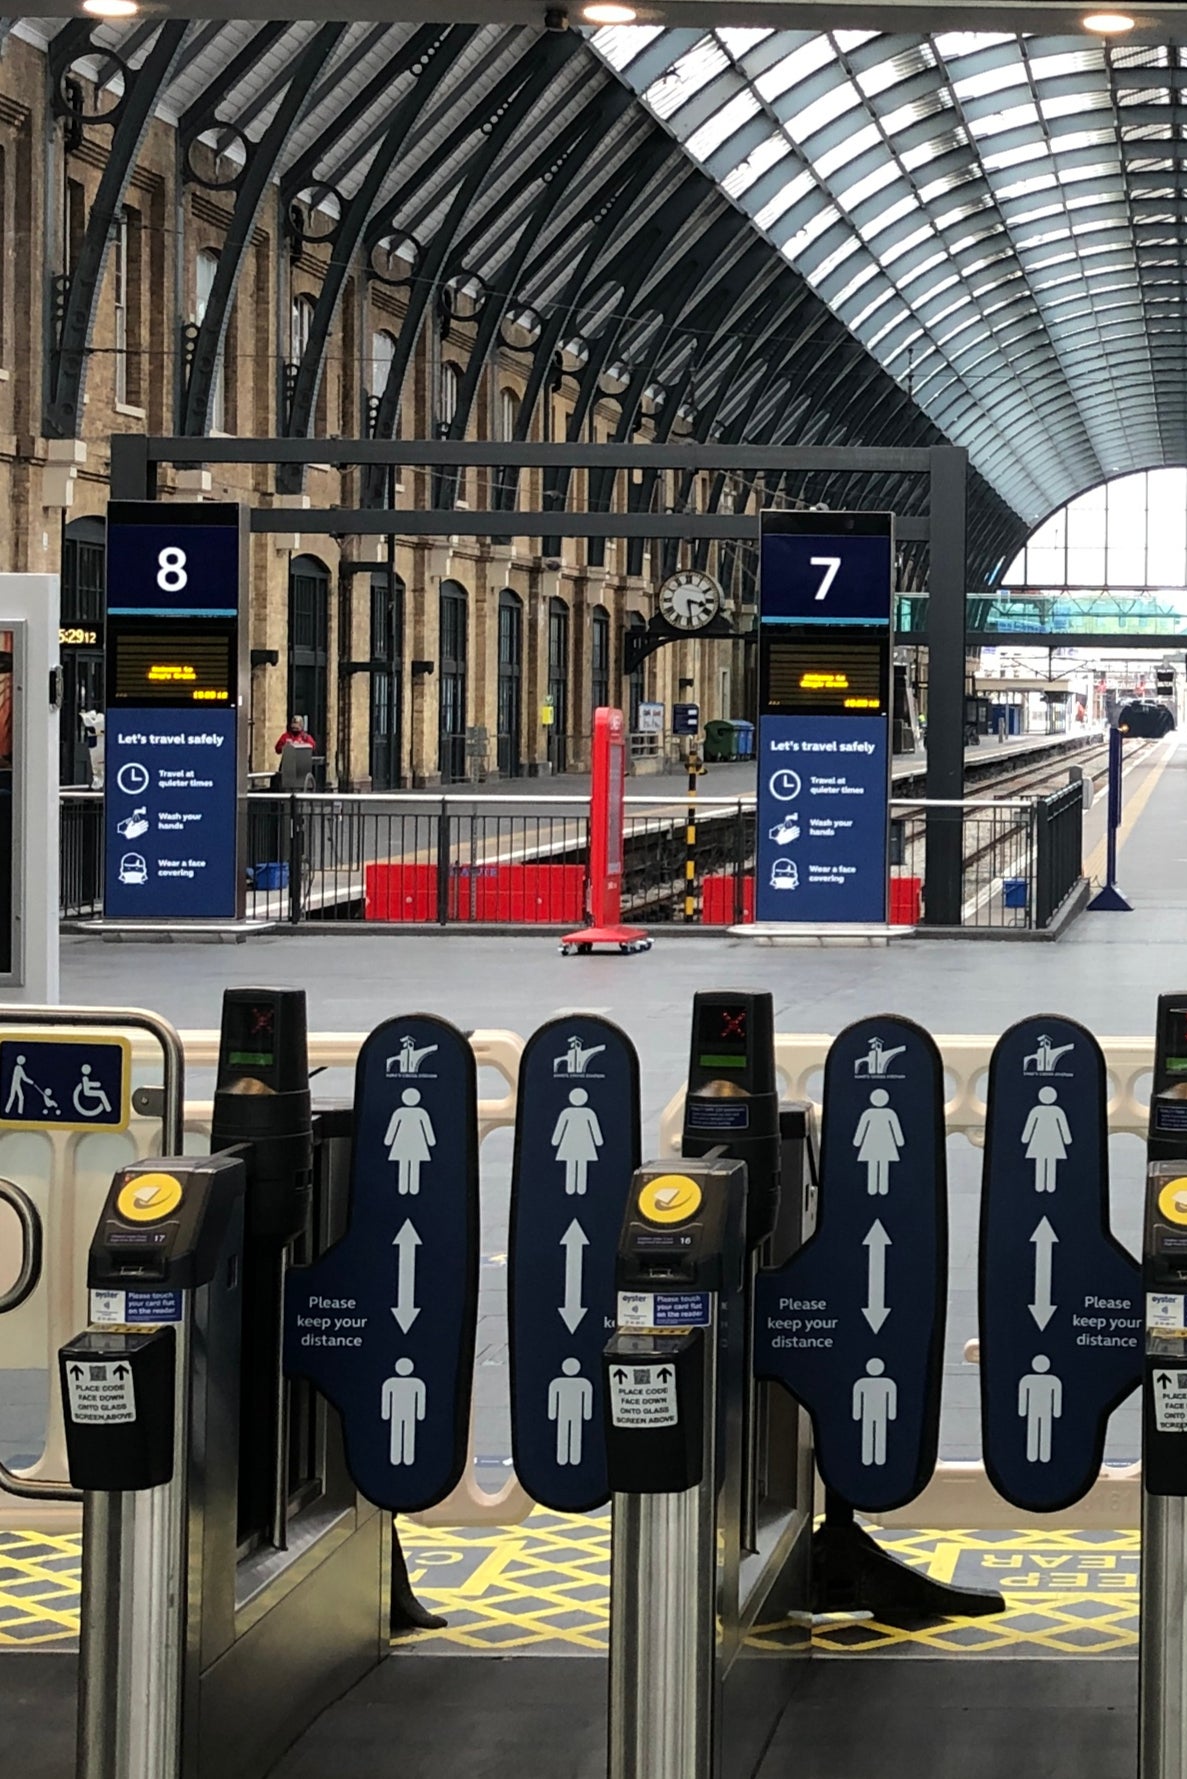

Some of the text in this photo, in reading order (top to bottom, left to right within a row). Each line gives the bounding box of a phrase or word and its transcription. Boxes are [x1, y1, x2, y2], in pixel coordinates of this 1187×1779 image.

[157, 546, 188, 592] 8
[809, 556, 841, 600] 7
[118, 733, 225, 747] Let's travel safely
[770, 740, 875, 755] Let's travel safely
[158, 769, 195, 778] Travel at
[158, 779, 213, 789] quieter times
[810, 776, 846, 785] Travel at
[810, 786, 864, 795] quieter times
[158, 812, 202, 823] Wash your
[158, 821, 184, 830] hands
[809, 818, 853, 829] Wash your
[809, 827, 835, 836] hands
[158, 859, 206, 868] Wear a face
[158, 868, 195, 878] covering
[809, 864, 831, 873] Wear
[839, 864, 857, 873] face
[809, 874, 845, 884] covering
[154, 1234, 165, 1242] 17
[680, 1237, 691, 1245] 16
[95, 1291, 119, 1299] oyster
[622, 1294, 647, 1303] oyster
[309, 1295, 356, 1309] Please
[779, 1297, 827, 1310] Please
[1084, 1296, 1131, 1310] Please
[1151, 1296, 1178, 1304] oyster
[667, 1310, 680, 1318] the
[297, 1314, 368, 1331] keep your
[767, 1317, 839, 1333] keep your
[1072, 1314, 1142, 1331] keep your
[300, 1333, 363, 1347] distance
[771, 1335, 834, 1348] distance
[1076, 1333, 1138, 1347] distance
[75, 1384, 125, 1392] PLACE CODE
[618, 1387, 668, 1396] PLACE CODE
[78, 1394, 124, 1402] FACE DOWN
[1162, 1392, 1187, 1400] PLACE
[642, 1397, 667, 1405] DOWN
[77, 1403, 127, 1411] ONTO GLASS
[643, 1406, 669, 1415] GLASS
[980, 1553, 1140, 1569] EAR
[1000, 1572, 1138, 1588] EEP
